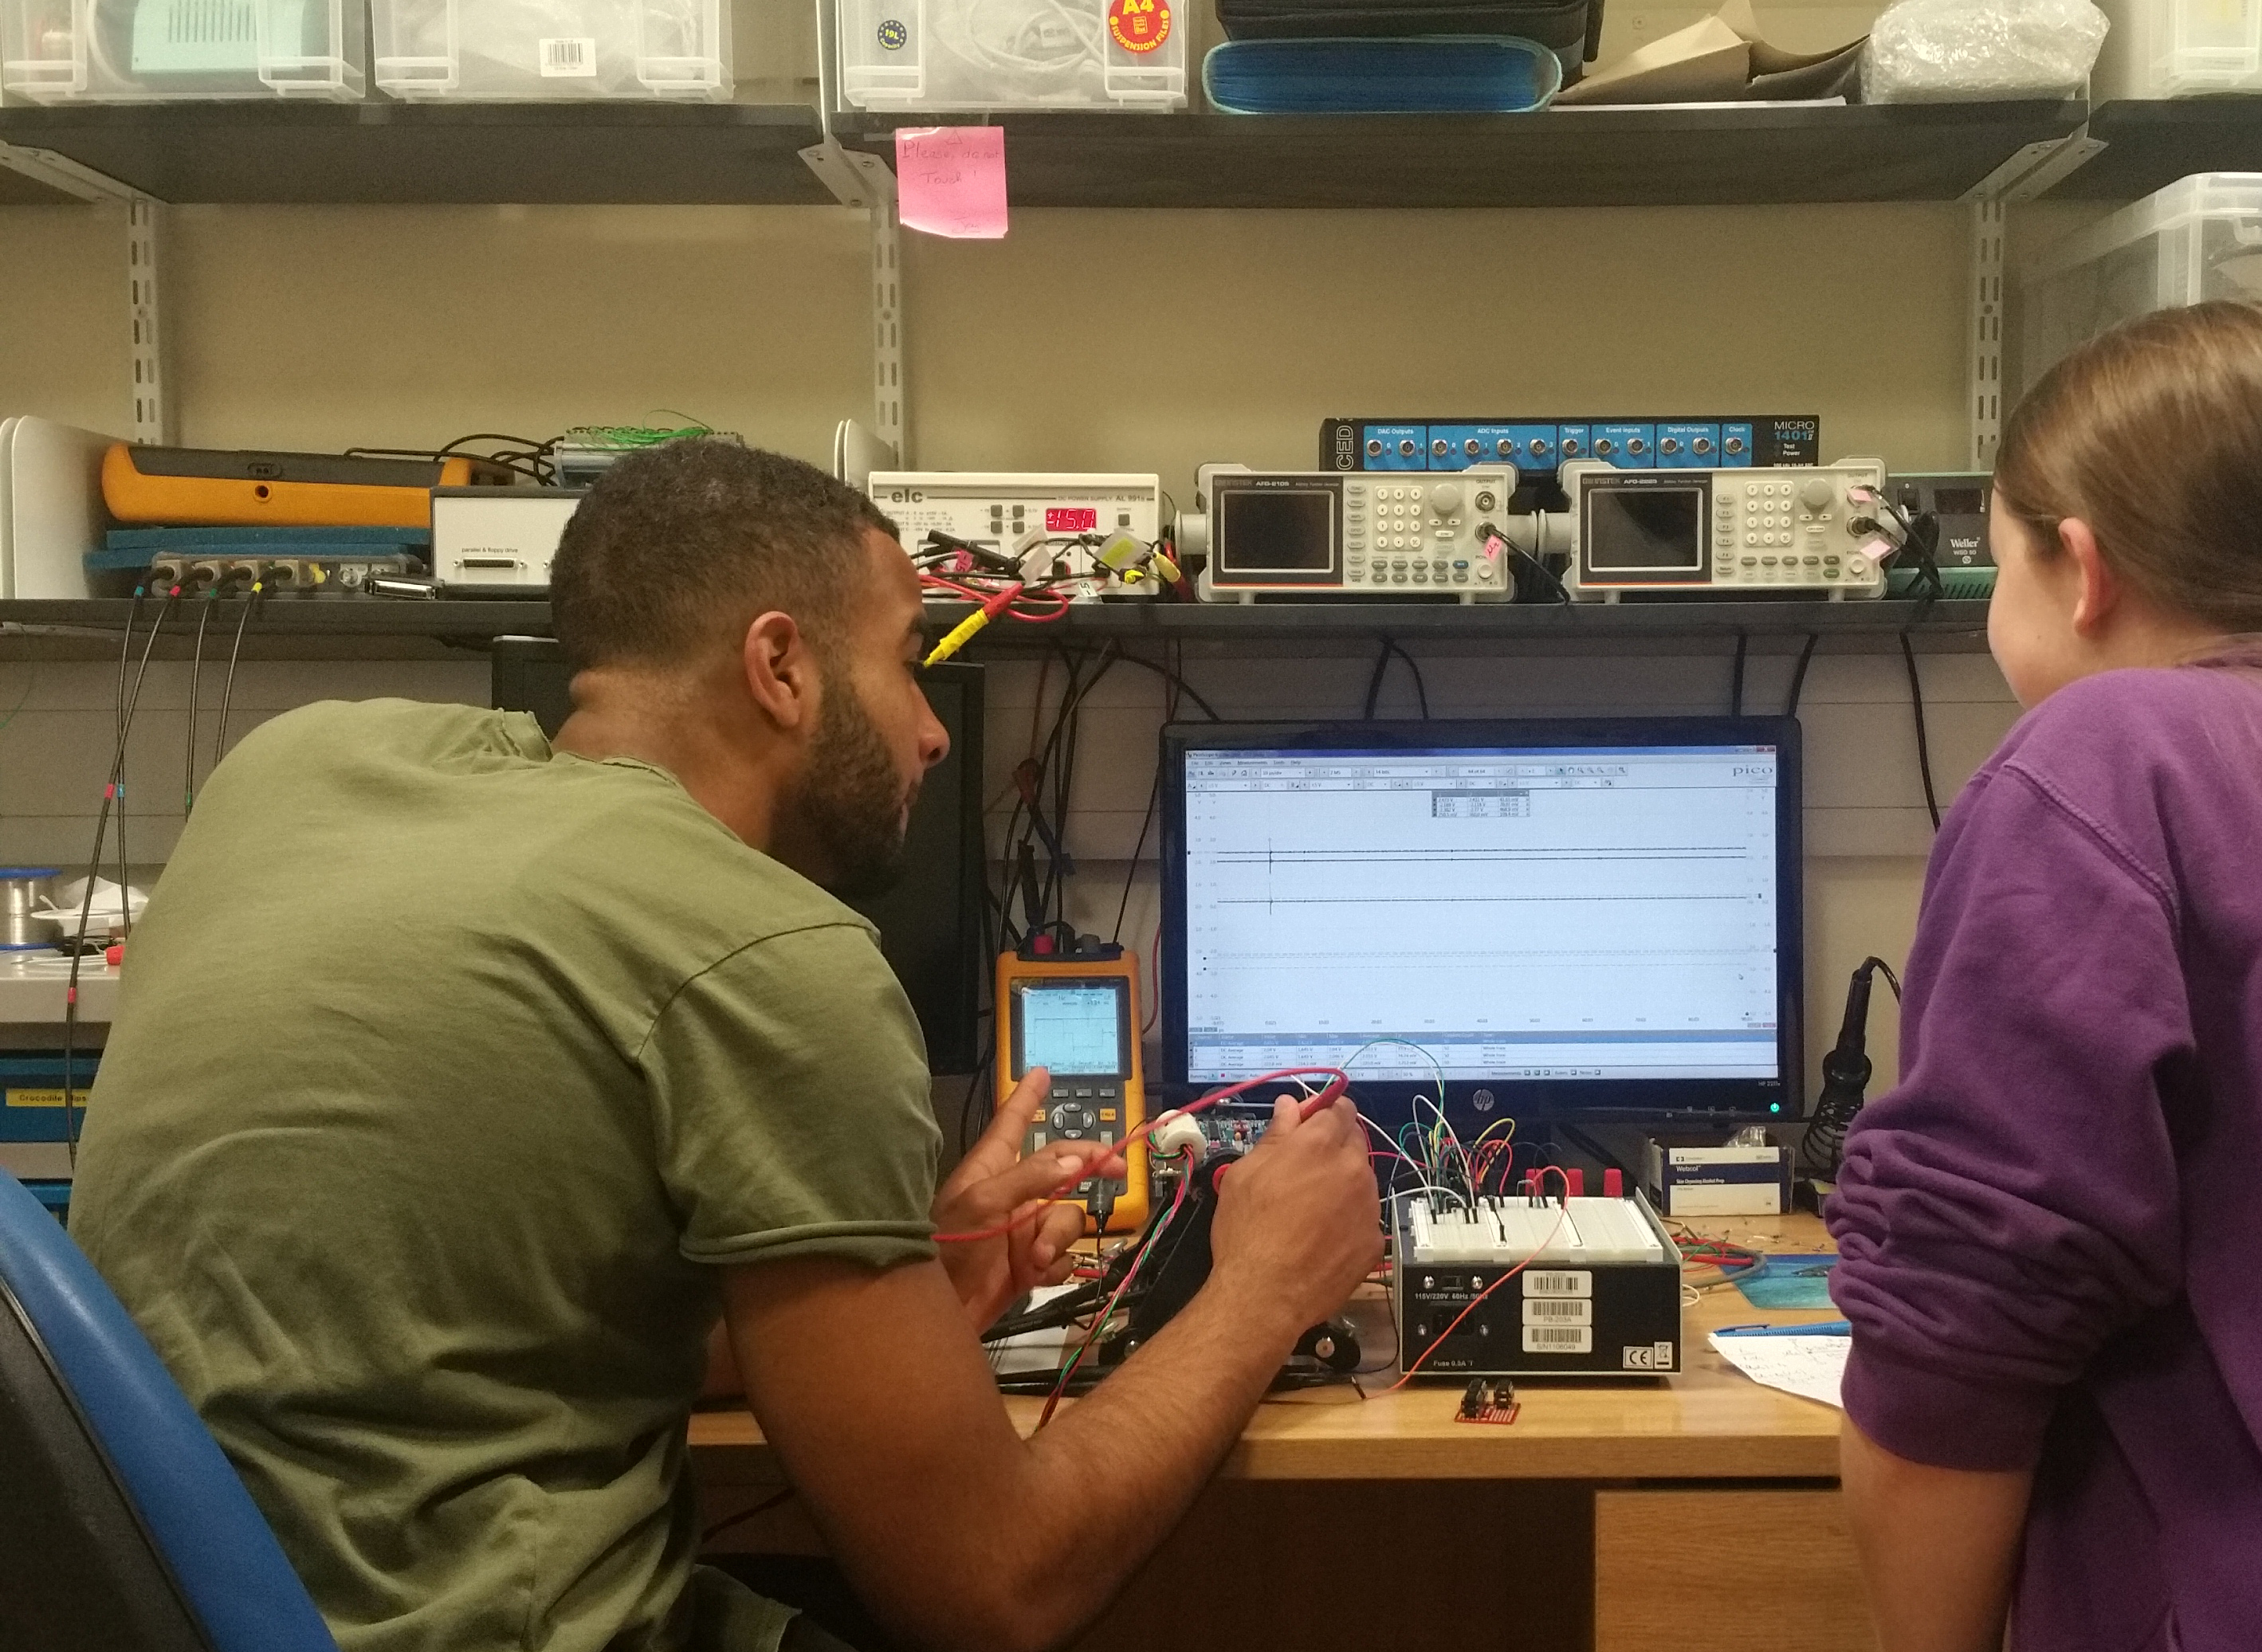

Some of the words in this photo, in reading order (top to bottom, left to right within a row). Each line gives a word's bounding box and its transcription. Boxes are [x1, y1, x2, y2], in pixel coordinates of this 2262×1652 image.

[1122, 0, 1154, 14] A4
[885, 29, 899, 40] 19L
[1112, 26, 1157, 50] SUSPENSION
[1156, 20, 1169, 42] FILES
[1564, 427, 1584, 436] Trigger
[1774, 421, 1815, 430] MICRO
[1774, 430, 1807, 441] 1401
[1336, 425, 1353, 470] CED
[891, 489, 923, 503] elc
[1950, 537, 1978, 548] Weller
[1733, 764, 1773, 777] pico
[1475, 1089, 1493, 1111] hp
